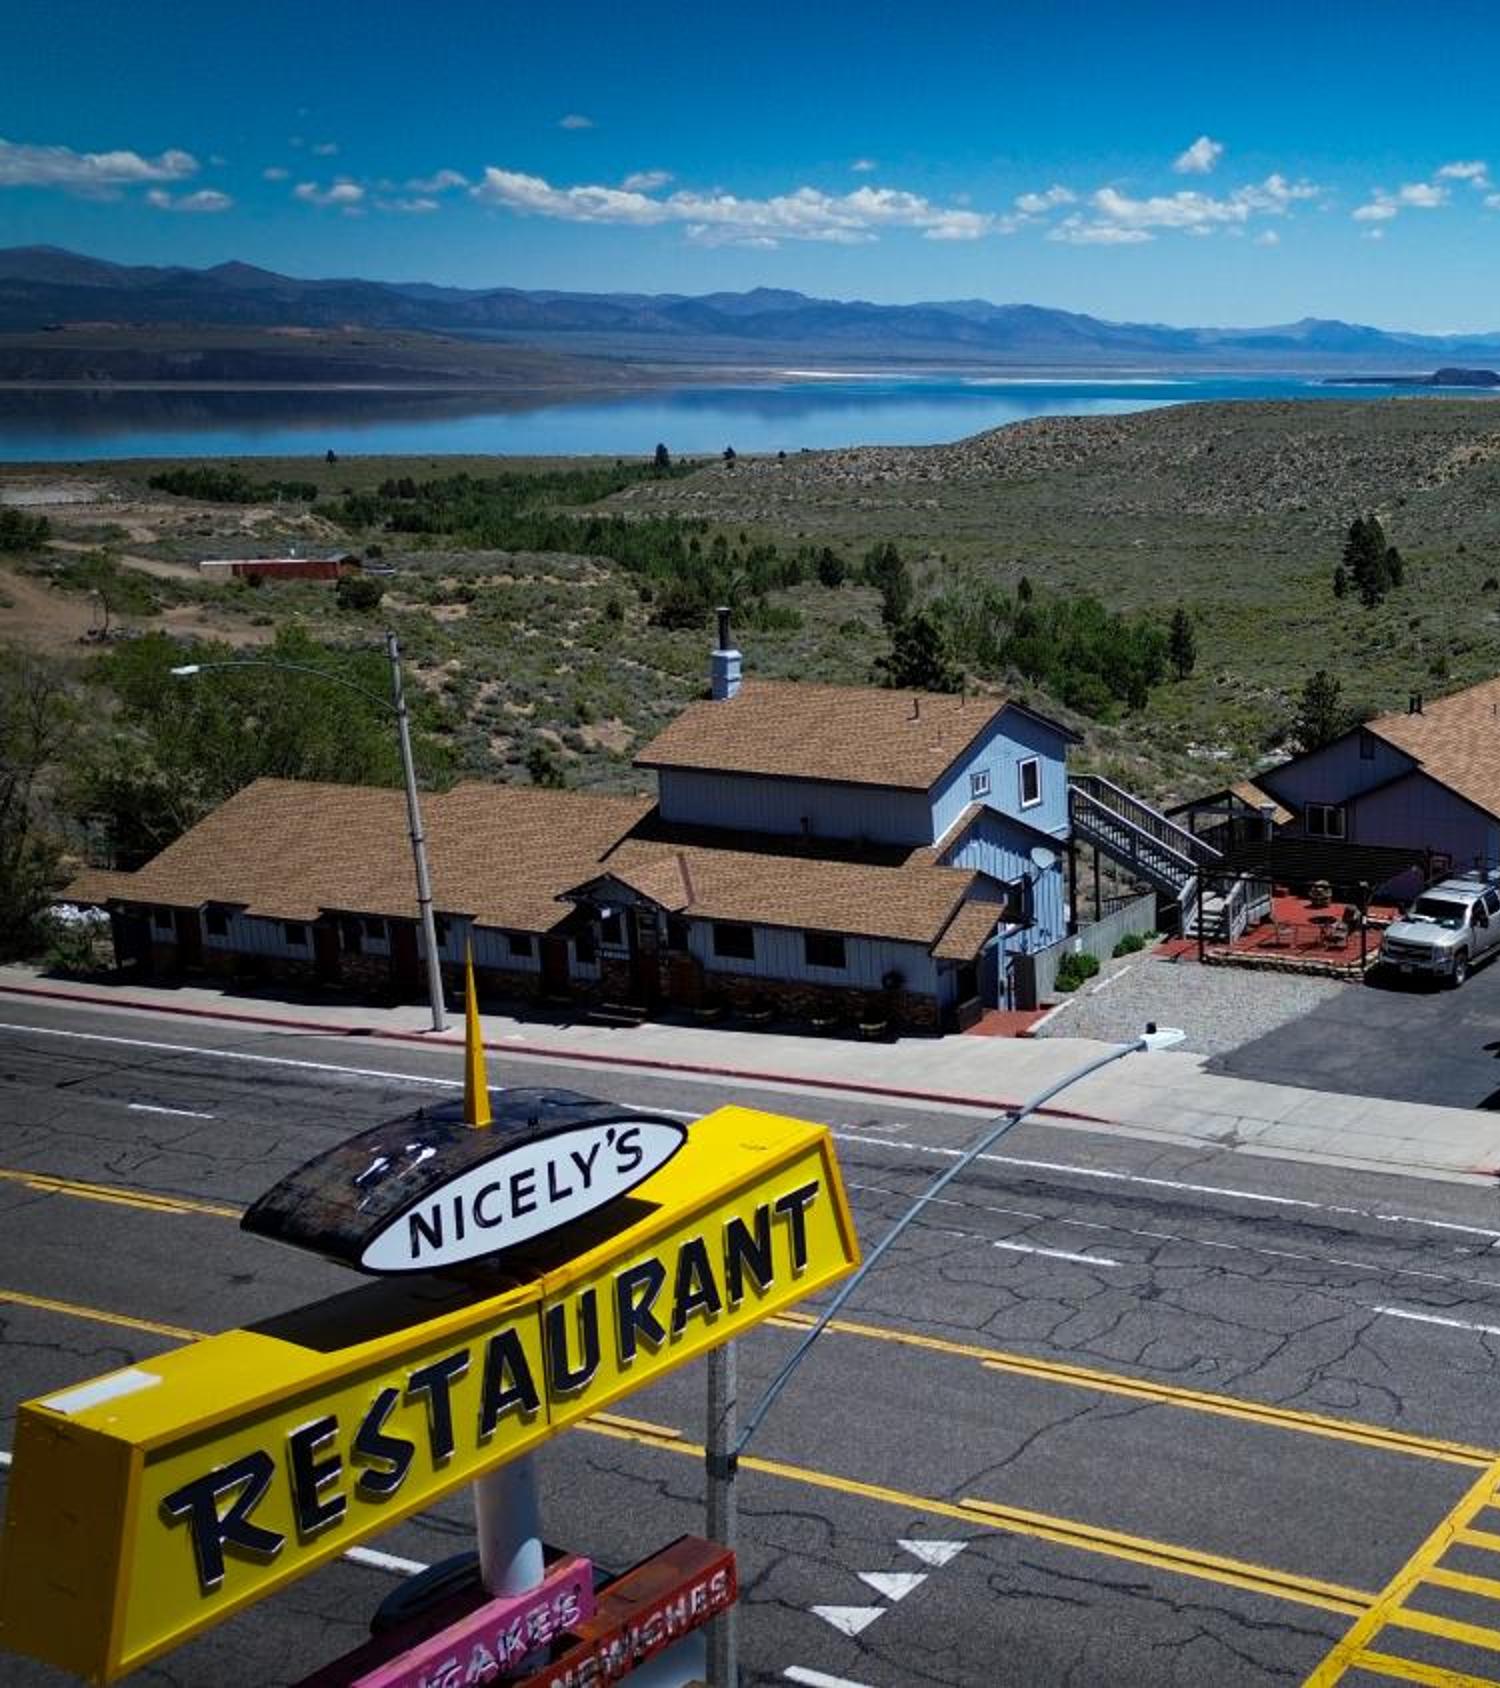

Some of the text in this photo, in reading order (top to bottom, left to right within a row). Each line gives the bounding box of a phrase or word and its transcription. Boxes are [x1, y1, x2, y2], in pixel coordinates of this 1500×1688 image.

[408, 1127, 643, 1260] NICELY'S
[160, 1180, 820, 1588] RESTAURANT
[418, 1592, 581, 1688] CAKES
